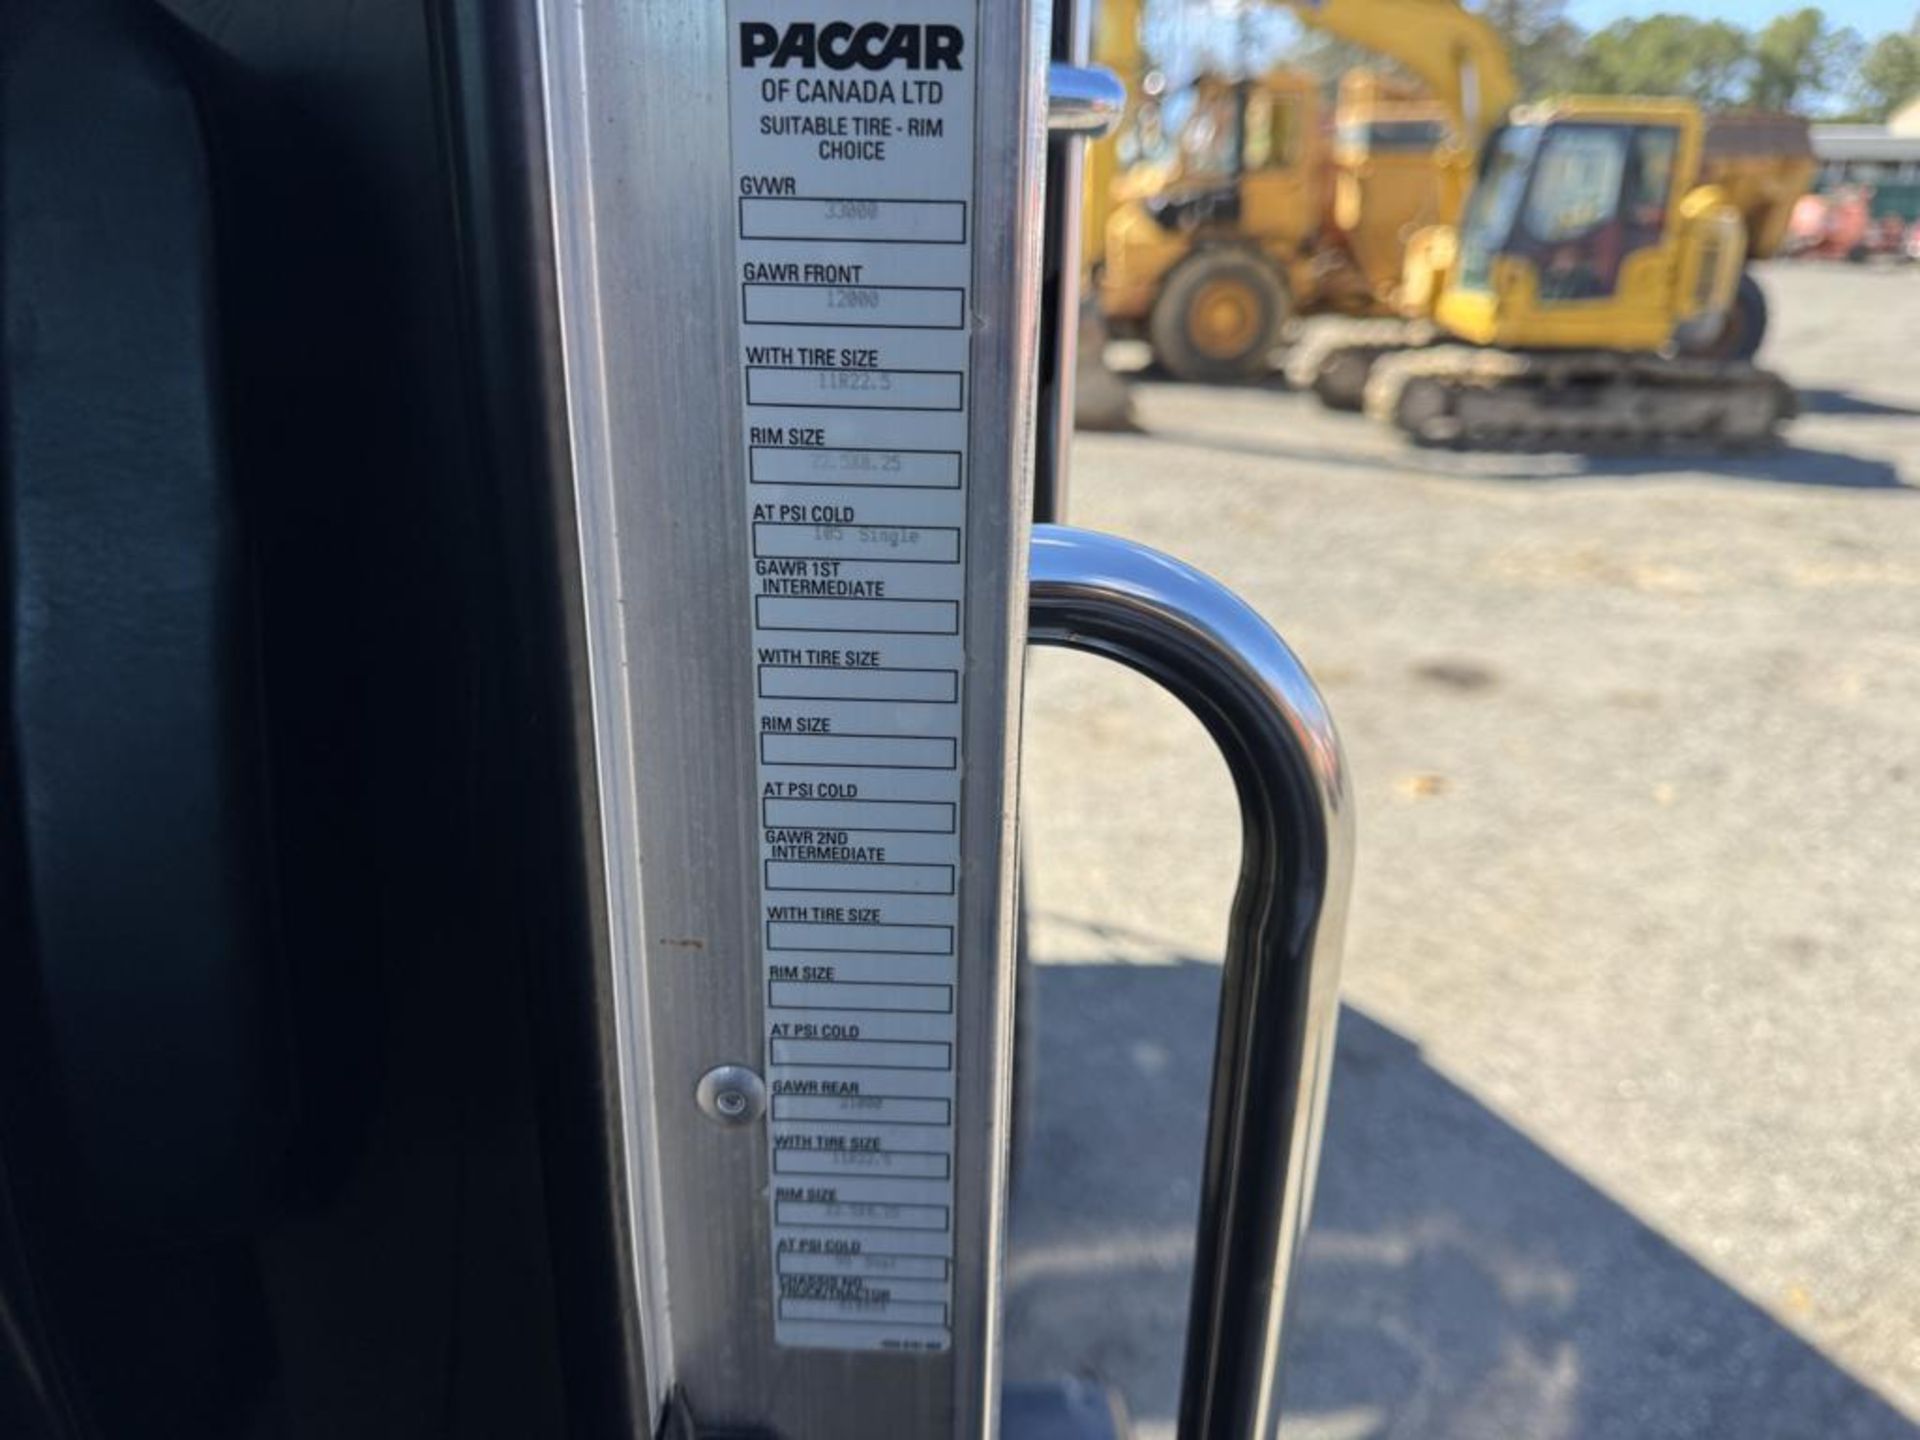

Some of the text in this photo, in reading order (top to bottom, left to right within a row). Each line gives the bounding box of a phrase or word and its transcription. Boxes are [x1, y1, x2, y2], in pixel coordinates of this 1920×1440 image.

[739, 21, 965, 71] PACCAR
[761, 78, 943, 104] OF CANADA LTD
[760, 115, 847, 136] SUITABLE
[853, 117, 891, 136] TIRE
[908, 118, 943, 138] RIM
[818, 141, 885, 160] CHOICE
[740, 176, 796, 195] GVWR
[743, 262, 863, 283] GAWR FRONT
[746, 347, 878, 367] WITH TIRE SIZE
[751, 428, 825, 446] RIM SIZE
[753, 505, 854, 523] AT PSI COLD
[859, 528, 920, 548] Single
[755, 561, 840, 577] GAWR 1ST
[762, 579, 885, 597] INTERMEDIATE
[758, 649, 881, 667] WITH TIRE SIZE
[761, 717, 831, 733] RIM SIZE
[764, 782, 858, 798] AT PSI COLD
[765, 830, 848, 846] GAWR 2ND
[771, 846, 886, 862] INTERMEDIATE
[767, 907, 881, 924] WITH TIRE SIZE
[769, 966, 835, 981] RIM SIZE
[771, 1024, 860, 1039] AT PSI COLD
[772, 1080, 860, 1095] GAWR REAR
[775, 1136, 812, 1149] WITH
